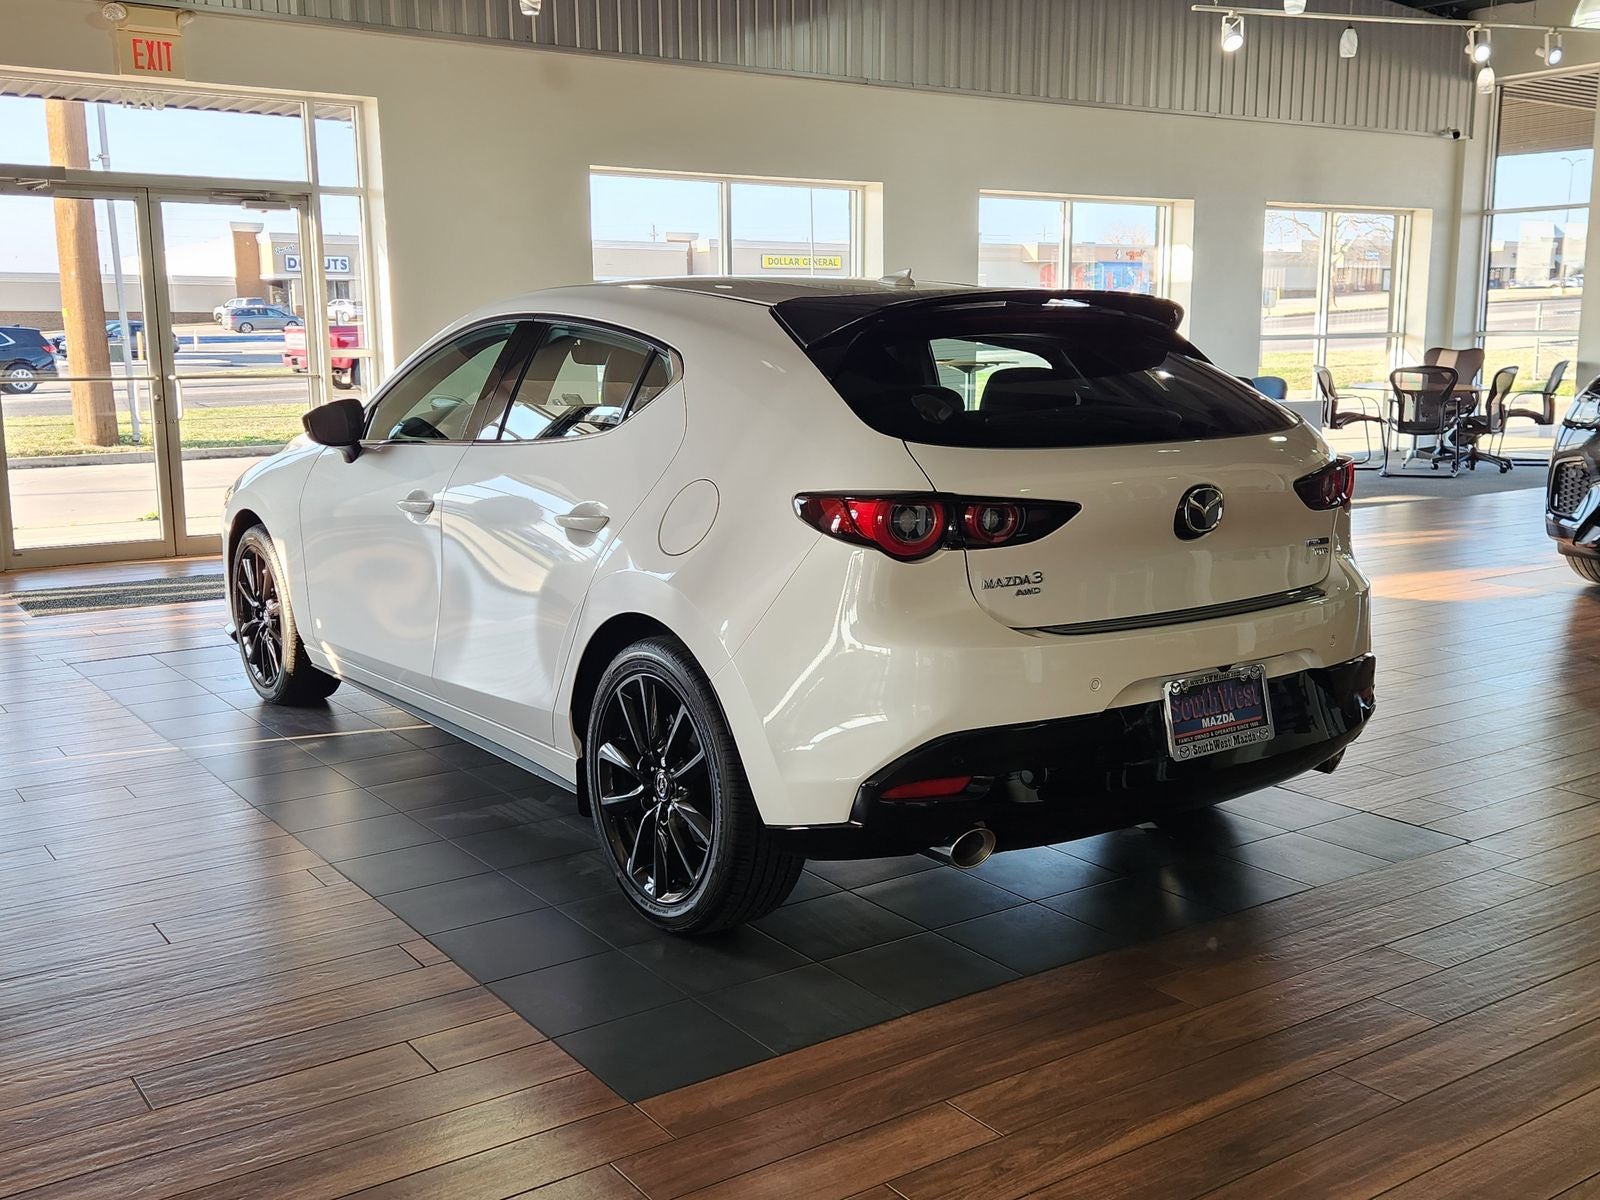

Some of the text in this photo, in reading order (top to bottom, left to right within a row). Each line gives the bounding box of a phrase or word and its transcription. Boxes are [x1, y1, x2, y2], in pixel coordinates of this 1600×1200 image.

[132, 38, 173, 72] EXIT
[767, 257, 839, 267] DOLLAR GENERAL
[982, 571, 1043, 590] MAZDA3
[1015, 587, 1041, 597] AWD
[1201, 711, 1236, 729] MAZDA
[1214, 725, 1237, 736] OPERATED
[1236, 723, 1249, 731] SINCE
[1232, 733, 1257, 746] Mazda
